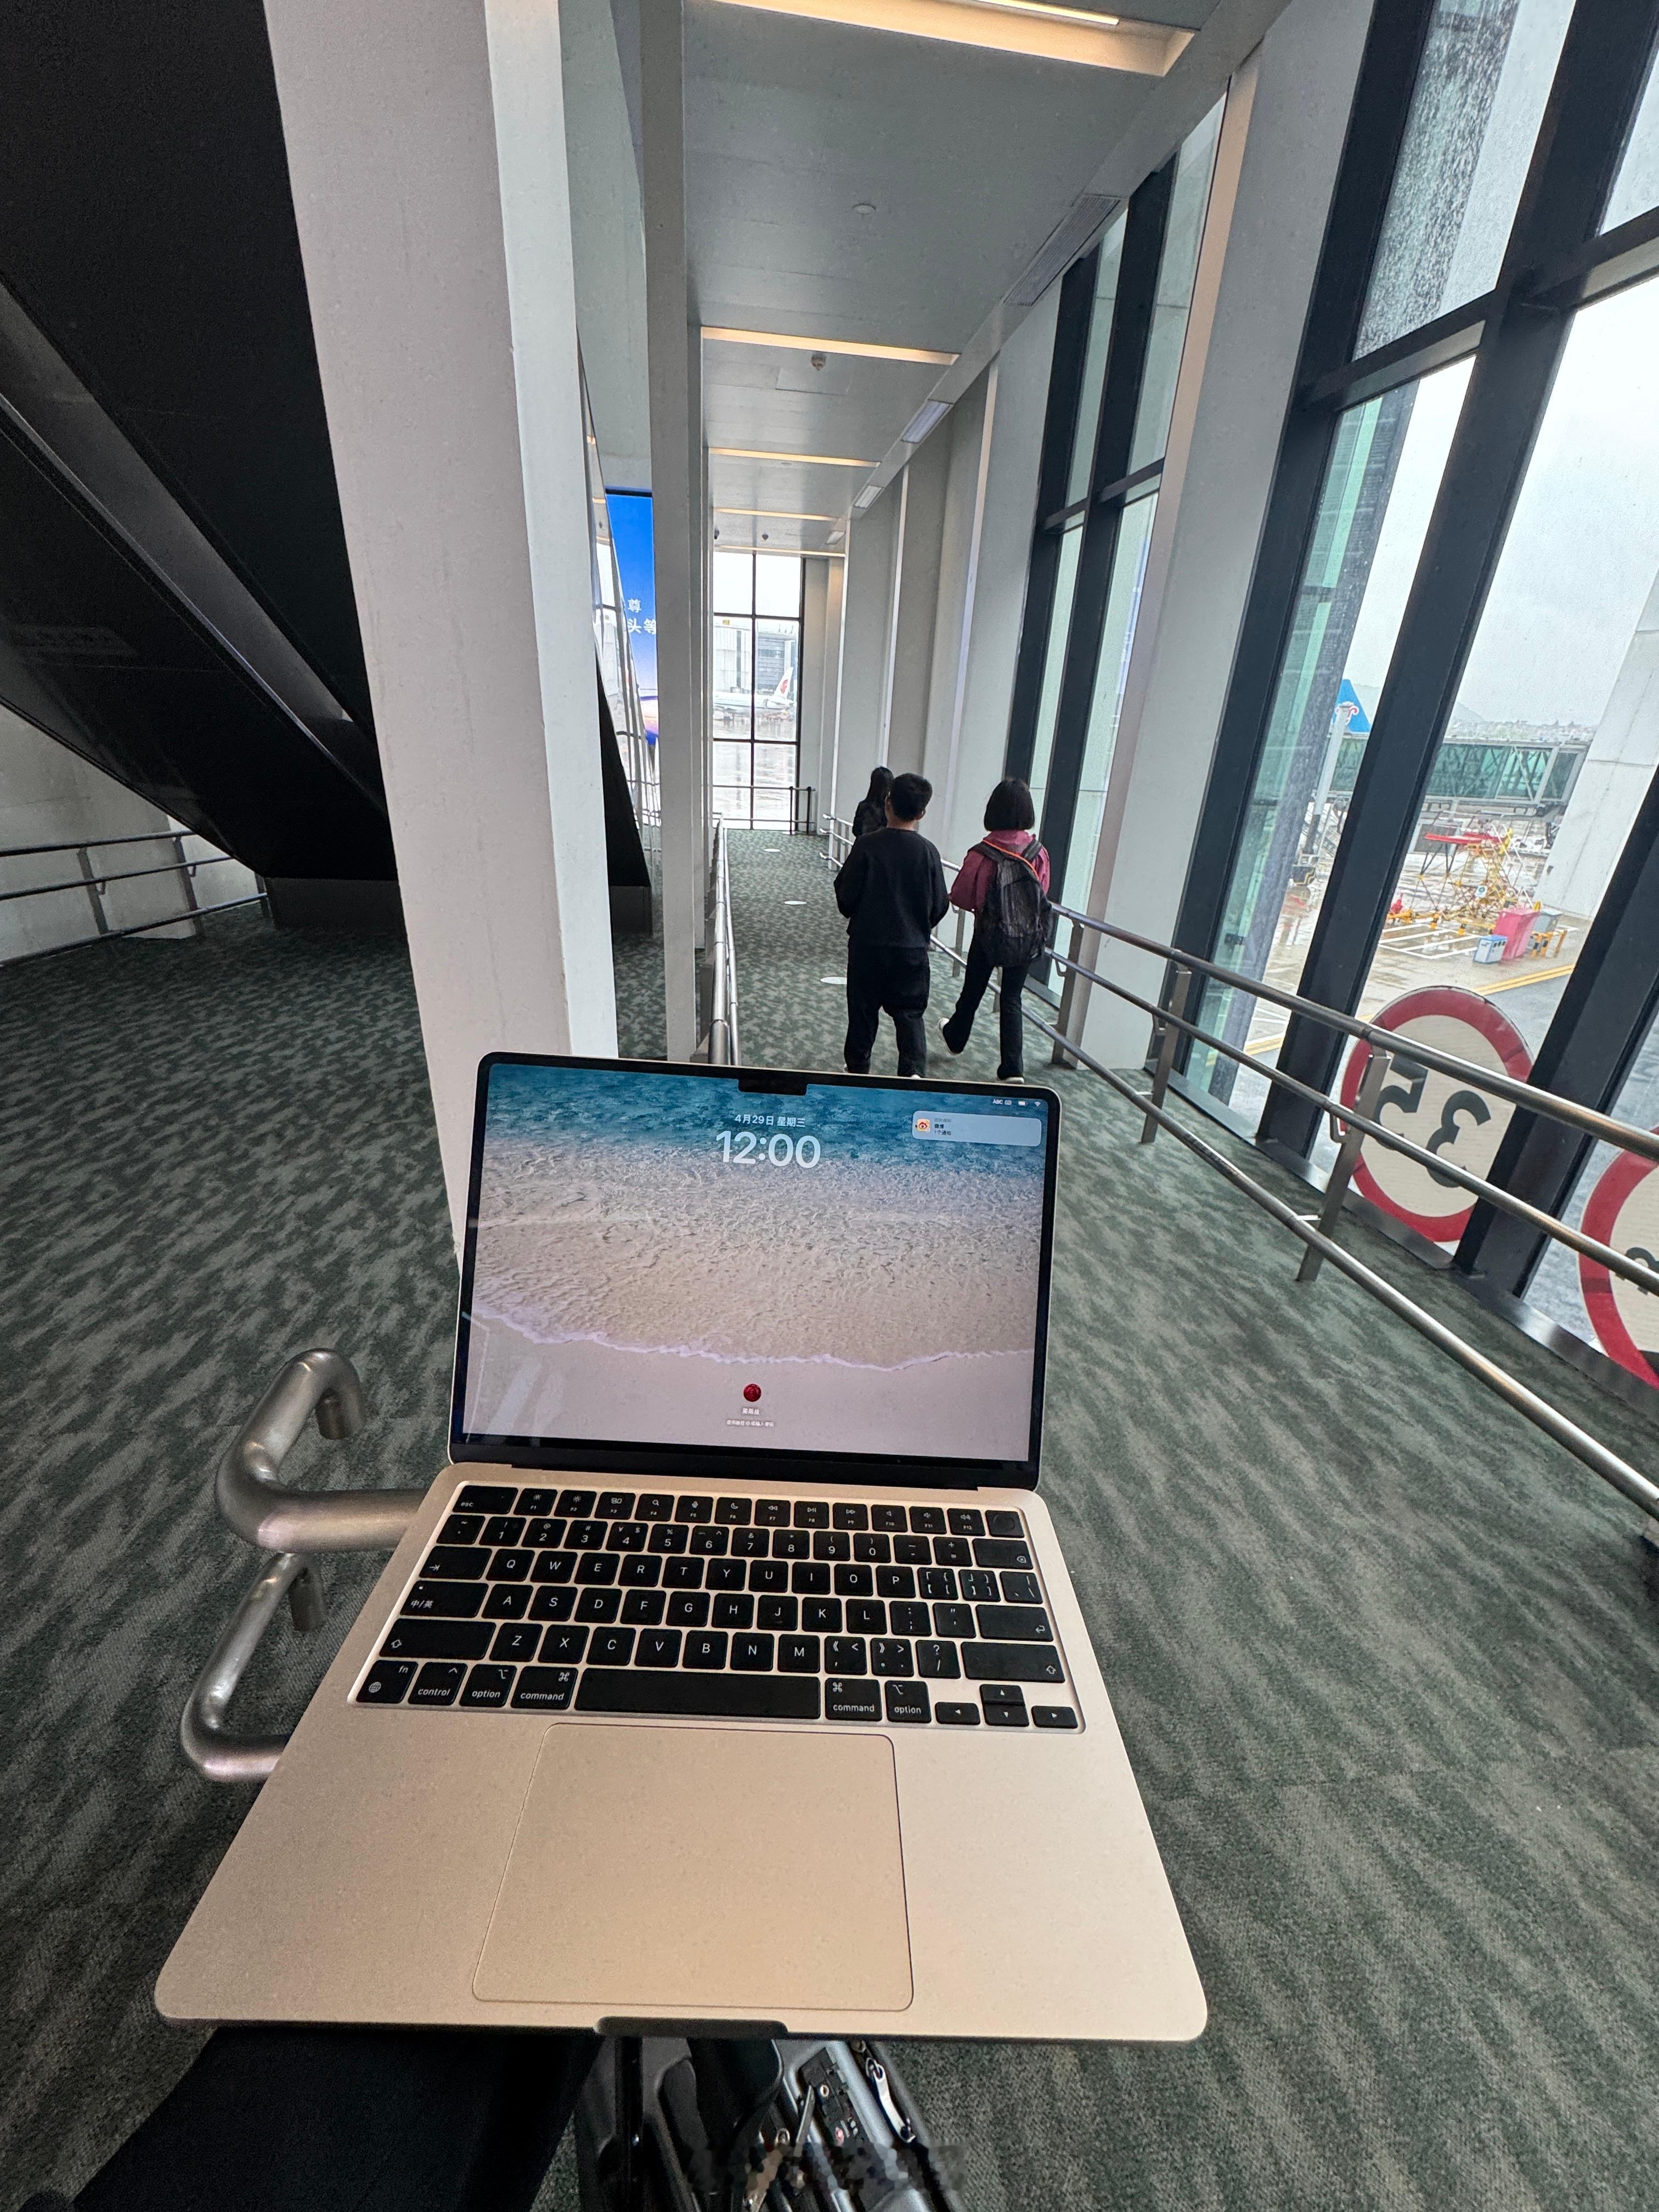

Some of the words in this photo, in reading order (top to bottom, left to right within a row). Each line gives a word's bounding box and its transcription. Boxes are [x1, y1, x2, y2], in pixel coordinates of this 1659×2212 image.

[628, 599, 642, 613] 尊
[627, 618, 657, 635] 头等
[734, 1114, 774, 1126] 4月29日
[777, 1116, 806, 1128] 星期三
[715, 1130, 821, 1169] 12:00
[499, 1531, 504, 1539] 1
[539, 1533, 547, 1541] 2
[580, 1534, 589, 1543] 3
[664, 1538, 672, 1547] 5
[706, 1540, 713, 1549] 6
[747, 1542, 754, 1550] 7
[787, 1544, 795, 1553] 8
[828, 1545, 836, 1554] 9
[868, 1547, 876, 1556] 0
[506, 1559, 516, 1569] Q
[550, 1561, 561, 1570] W
[594, 1563, 602, 1572] E
[636, 1565, 645, 1573] R
[680, 1567, 688, 1576] T
[723, 1569, 731, 1578] Y
[765, 1571, 773, 1579] U
[810, 1572, 813, 1581] I
[849, 1574, 857, 1583] O
[892, 1576, 900, 1584] P
[410, 1599, 433, 1609] 中/英
[503, 1596, 511, 1605] A
[549, 1597, 558, 1607] S
[594, 1599, 603, 1609] D
[640, 1600, 648, 1610] F
[684, 1602, 693, 1613] G
[729, 1605, 738, 1615] H
[774, 1607, 781, 1616] J
[819, 1609, 826, 1618] K
[864, 1610, 870, 1620] L
[511, 1635, 522, 1646] Z
[560, 1638, 570, 1648] X
[607, 1639, 617, 1650] C
[655, 1641, 664, 1651] V
[702, 1643, 710, 1654] B
[748, 1645, 757, 1655] N
[794, 1646, 804, 1657] M
[933, 1644, 940, 1655] ?
[417, 1688, 450, 1696] control
[472, 1690, 501, 1699] option
[520, 1692, 565, 1701] command
[833, 1704, 875, 1712] command
[894, 1705, 922, 1715] option
